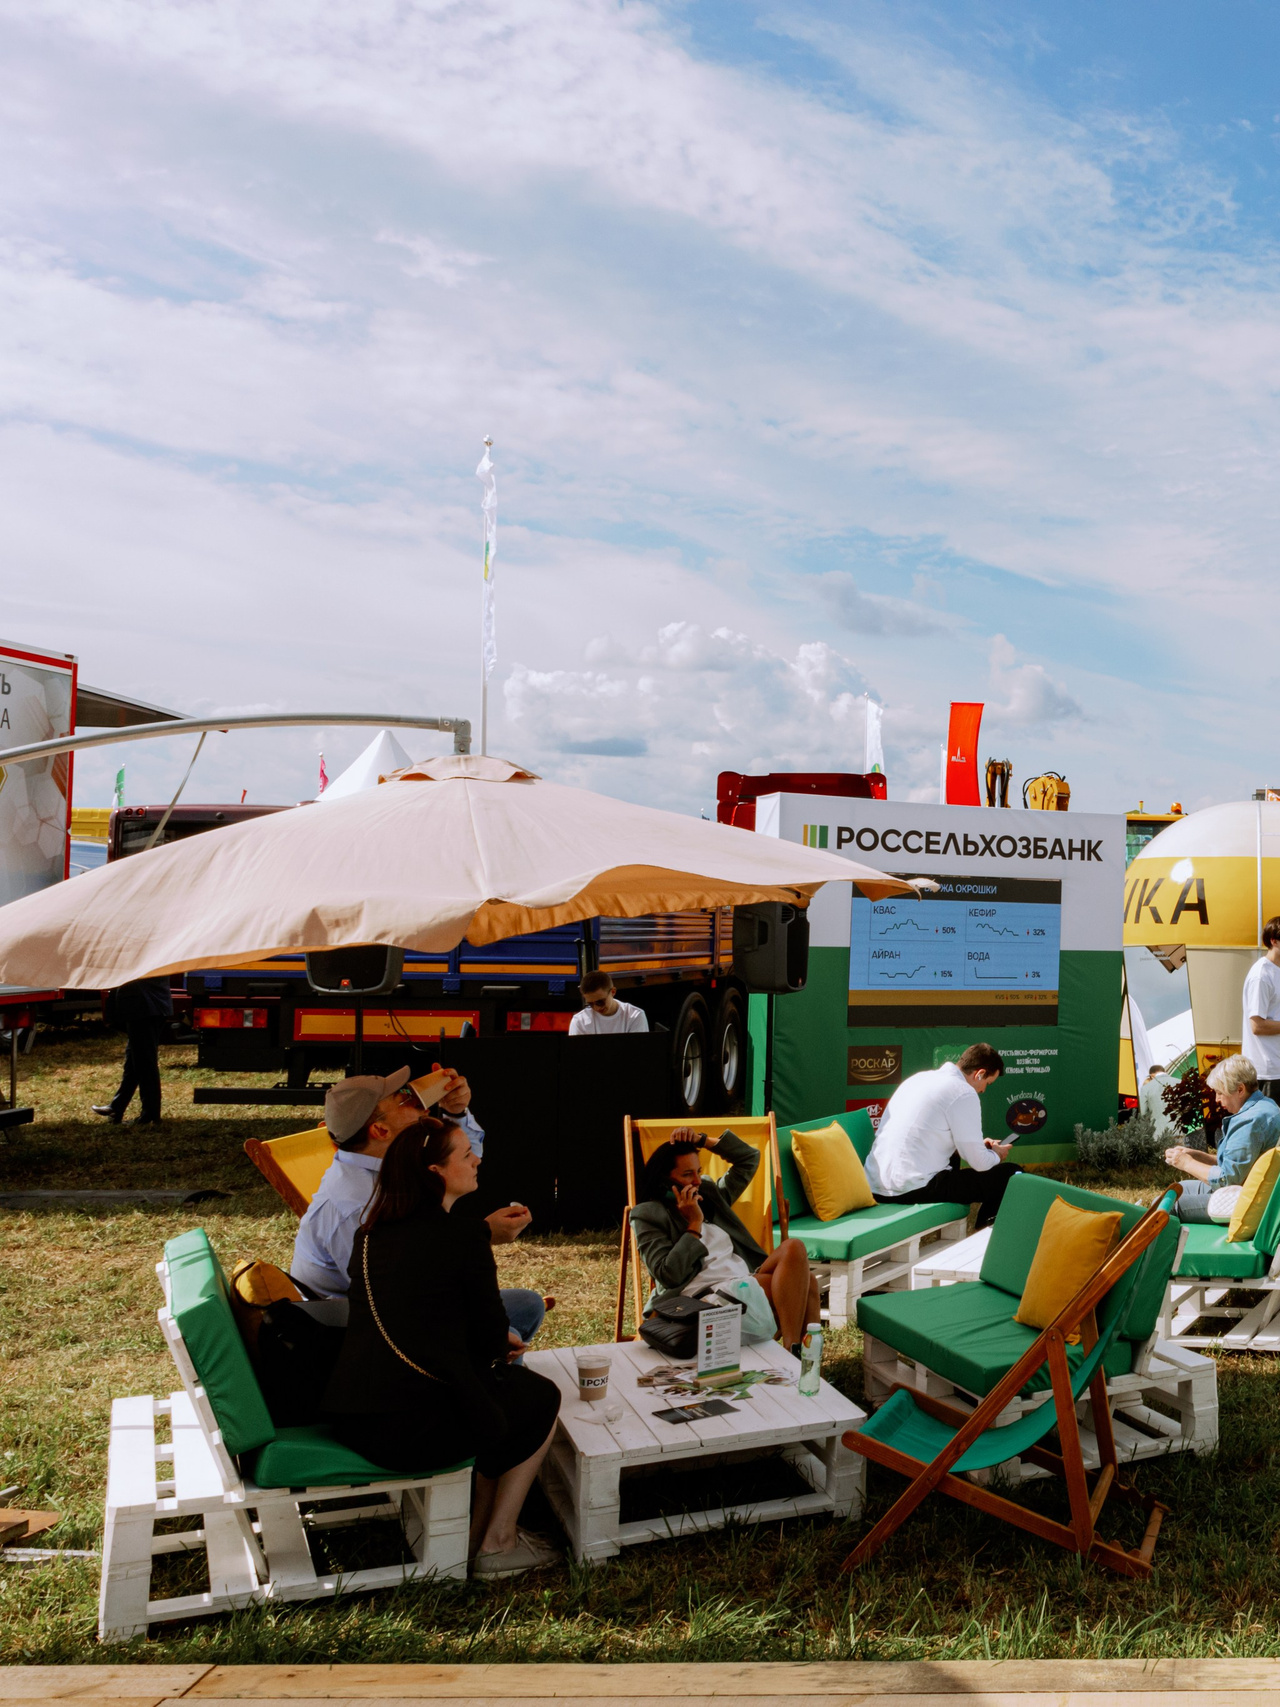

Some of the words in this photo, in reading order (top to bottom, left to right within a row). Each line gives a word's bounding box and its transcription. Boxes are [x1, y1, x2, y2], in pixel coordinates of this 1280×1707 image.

[836, 826, 1104, 862] РОССЕЛЬХОЗБАНК
[955, 883, 997, 895] ОКРОШКИ
[873, 905, 896, 915] КВАС
[968, 908, 997, 918] КЕФИР
[942, 926, 956, 934] 50%
[1032, 928, 1046, 936] 32%
[871, 948, 900, 960] АЙРАН
[967, 952, 990, 962] ВОДА
[940, 970, 953, 978] 15%
[851, 1058, 896, 1069] РОСКАР
